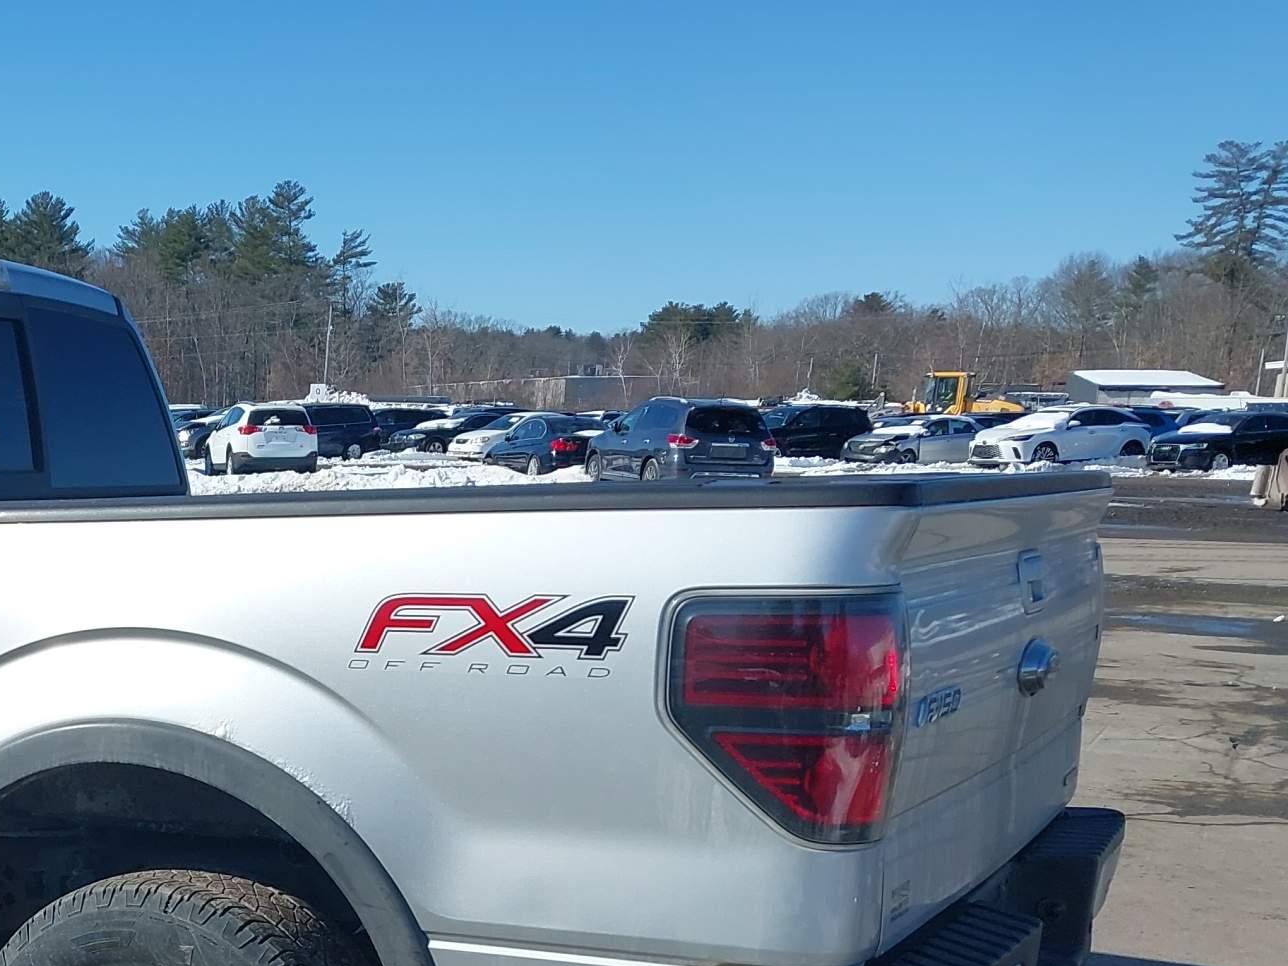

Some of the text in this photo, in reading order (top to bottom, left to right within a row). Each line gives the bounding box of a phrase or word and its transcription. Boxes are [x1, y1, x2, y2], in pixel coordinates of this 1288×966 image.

[354, 593, 635, 660] FX4
[348, 659, 611, 678] OFF ROAD
